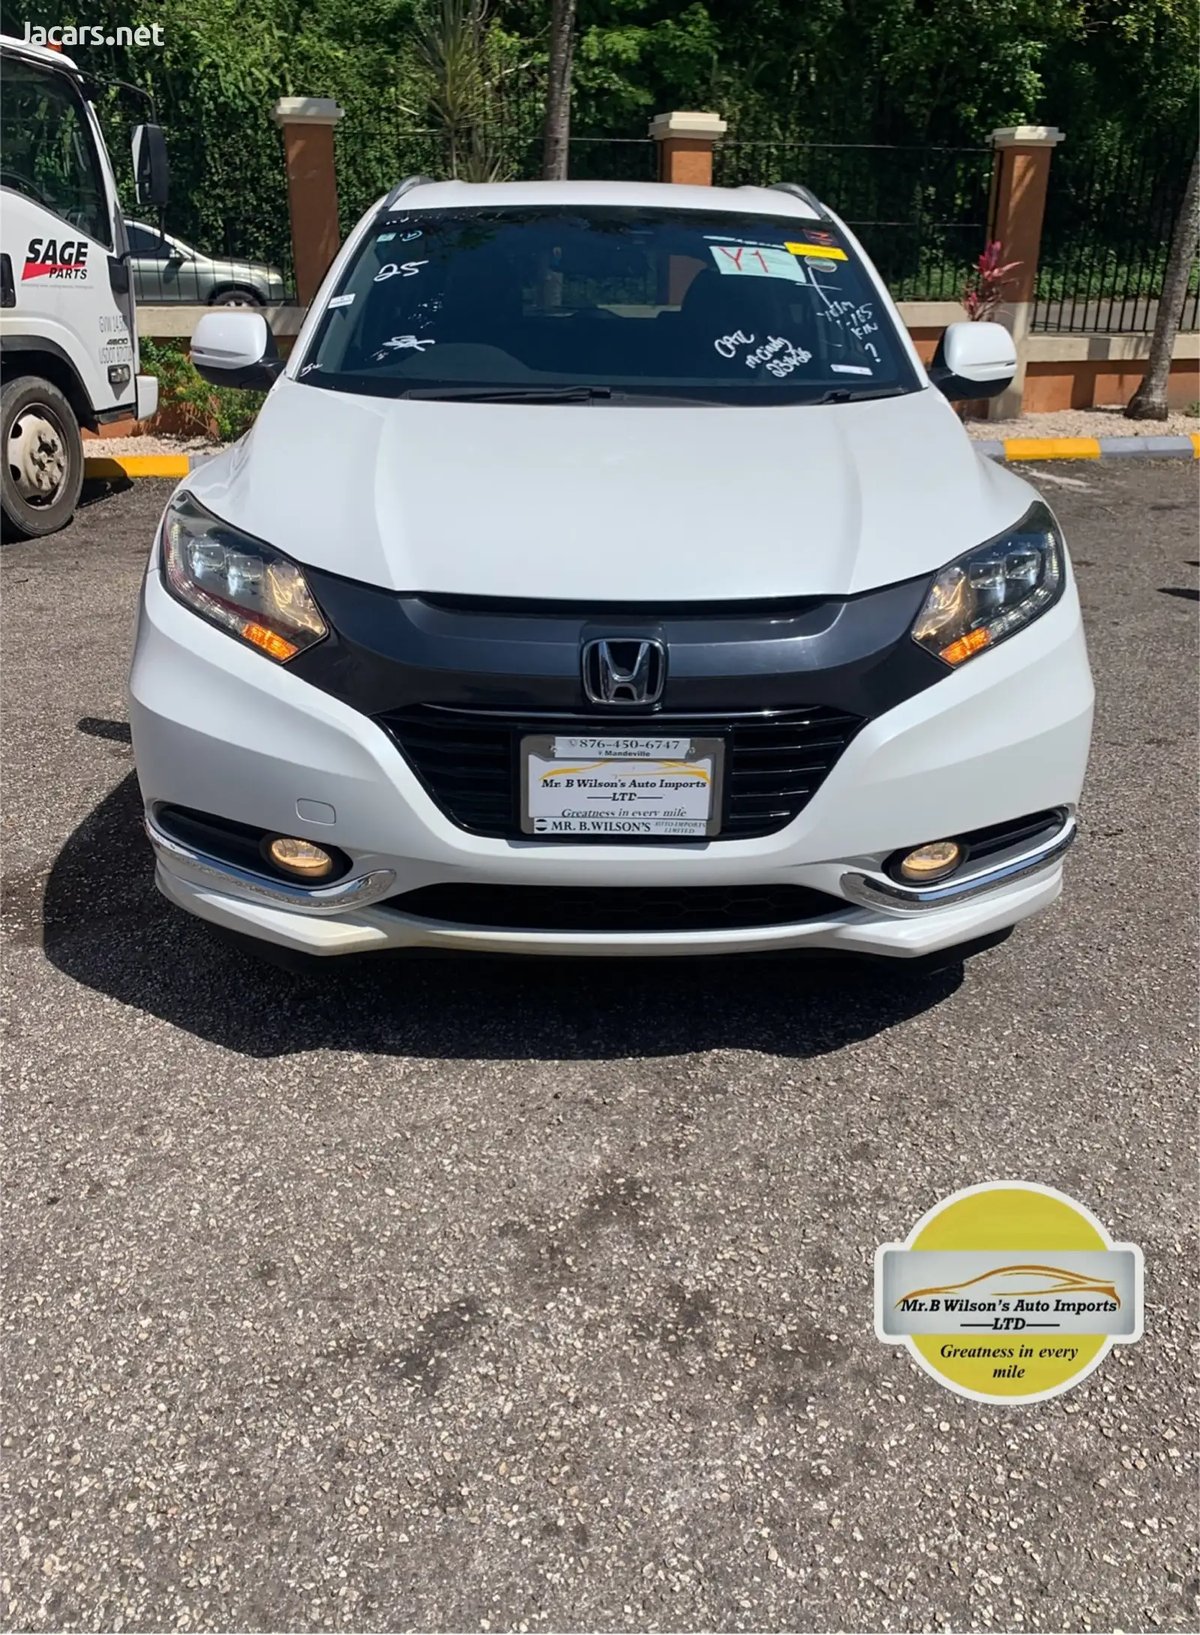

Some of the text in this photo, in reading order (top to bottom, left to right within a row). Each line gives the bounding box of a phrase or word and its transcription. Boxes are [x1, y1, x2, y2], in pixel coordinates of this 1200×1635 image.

[25, 238, 89, 267] SAGE
[718, 246, 769, 274] Y1
[48, 267, 88, 280] PARTS
[373, 259, 430, 282] 25
[579, 738, 681, 750] 876-450-6747
[565, 779, 574, 788] B
[577, 778, 626, 788] Wilson's
[628, 779, 657, 788] Auto
[659, 779, 707, 790] Imports
[618, 808, 630, 817] in
[663, 807, 688, 818] mile
[551, 820, 576, 832] MR.
